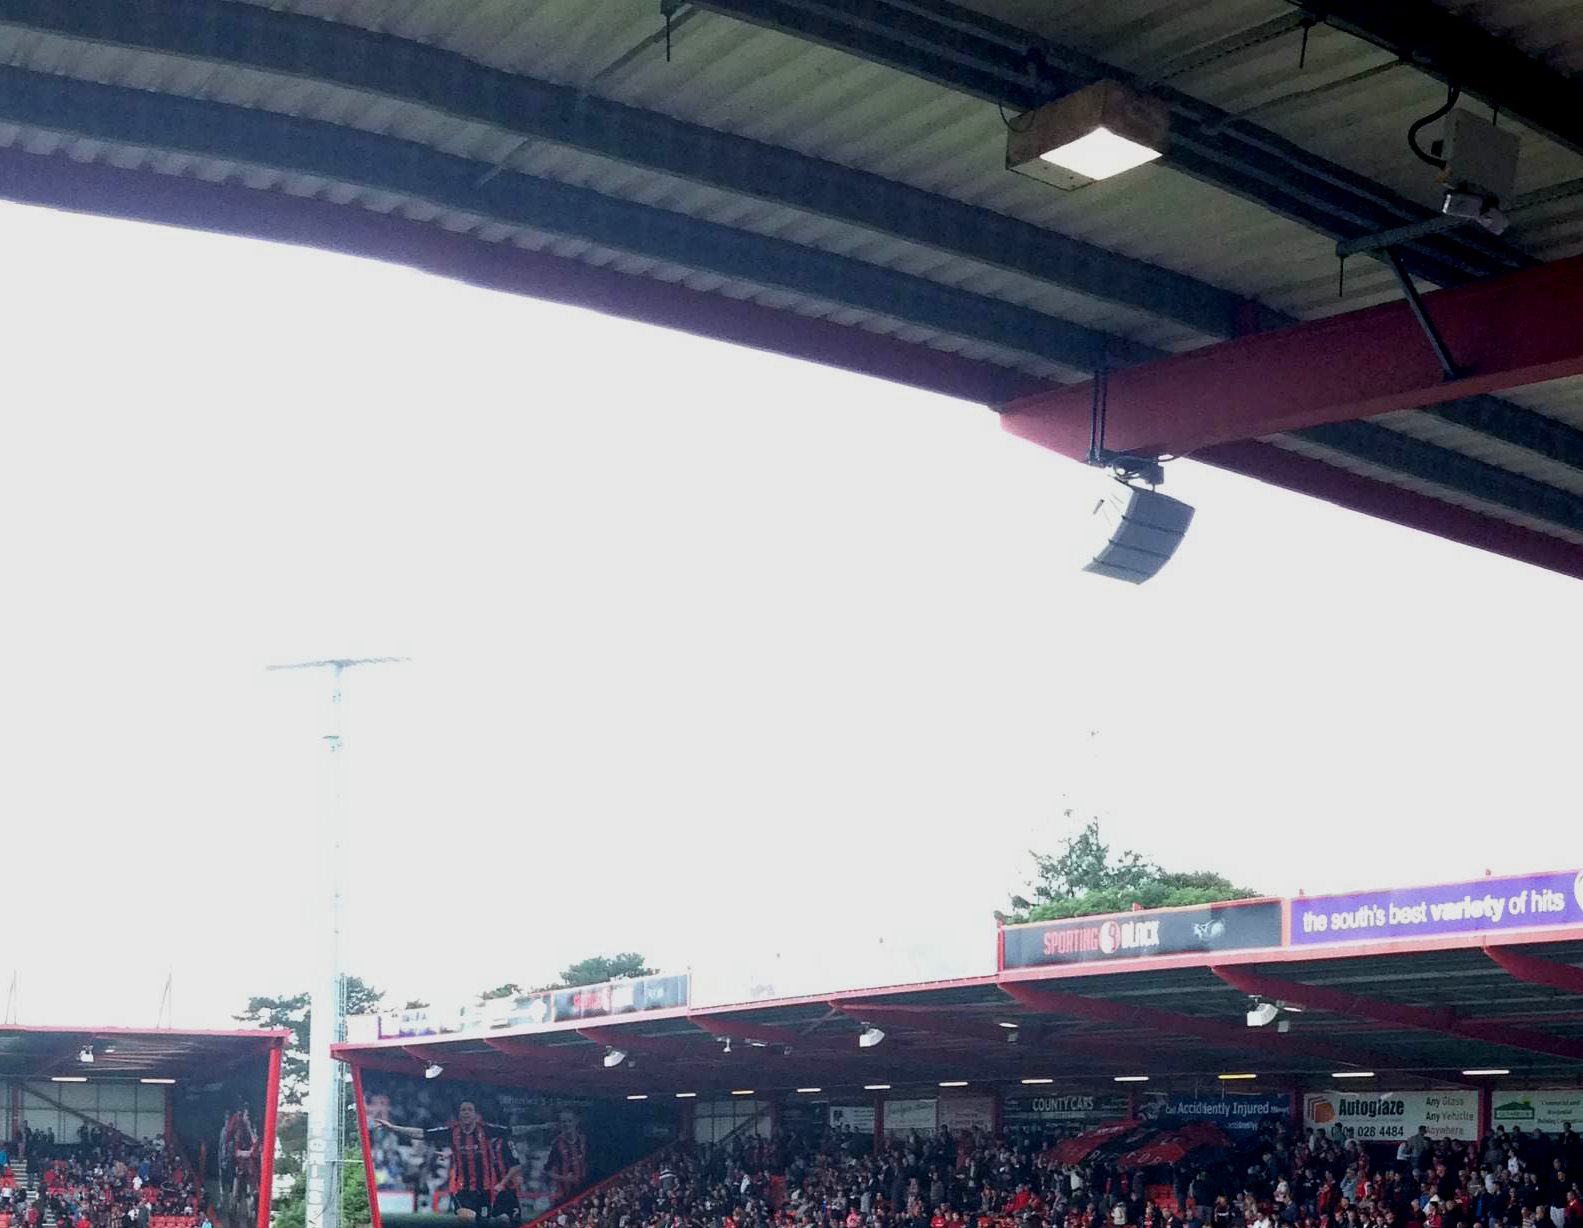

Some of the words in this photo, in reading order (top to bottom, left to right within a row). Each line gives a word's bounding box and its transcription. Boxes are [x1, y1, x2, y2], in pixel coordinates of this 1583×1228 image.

[1303, 910, 1327, 932] the
[1331, 904, 1385, 929] south's
[1389, 902, 1427, 925] best
[1430, 894, 1505, 922] variety
[1508, 890, 1528, 914] of
[1531, 888, 1565, 911] hits
[1043, 927, 1099, 955] SPORTING
[1233, 1101, 1270, 1114] Injured
[1339, 1098, 1404, 1117] Autoglaze
[1379, 1126, 1404, 1137] 4484
